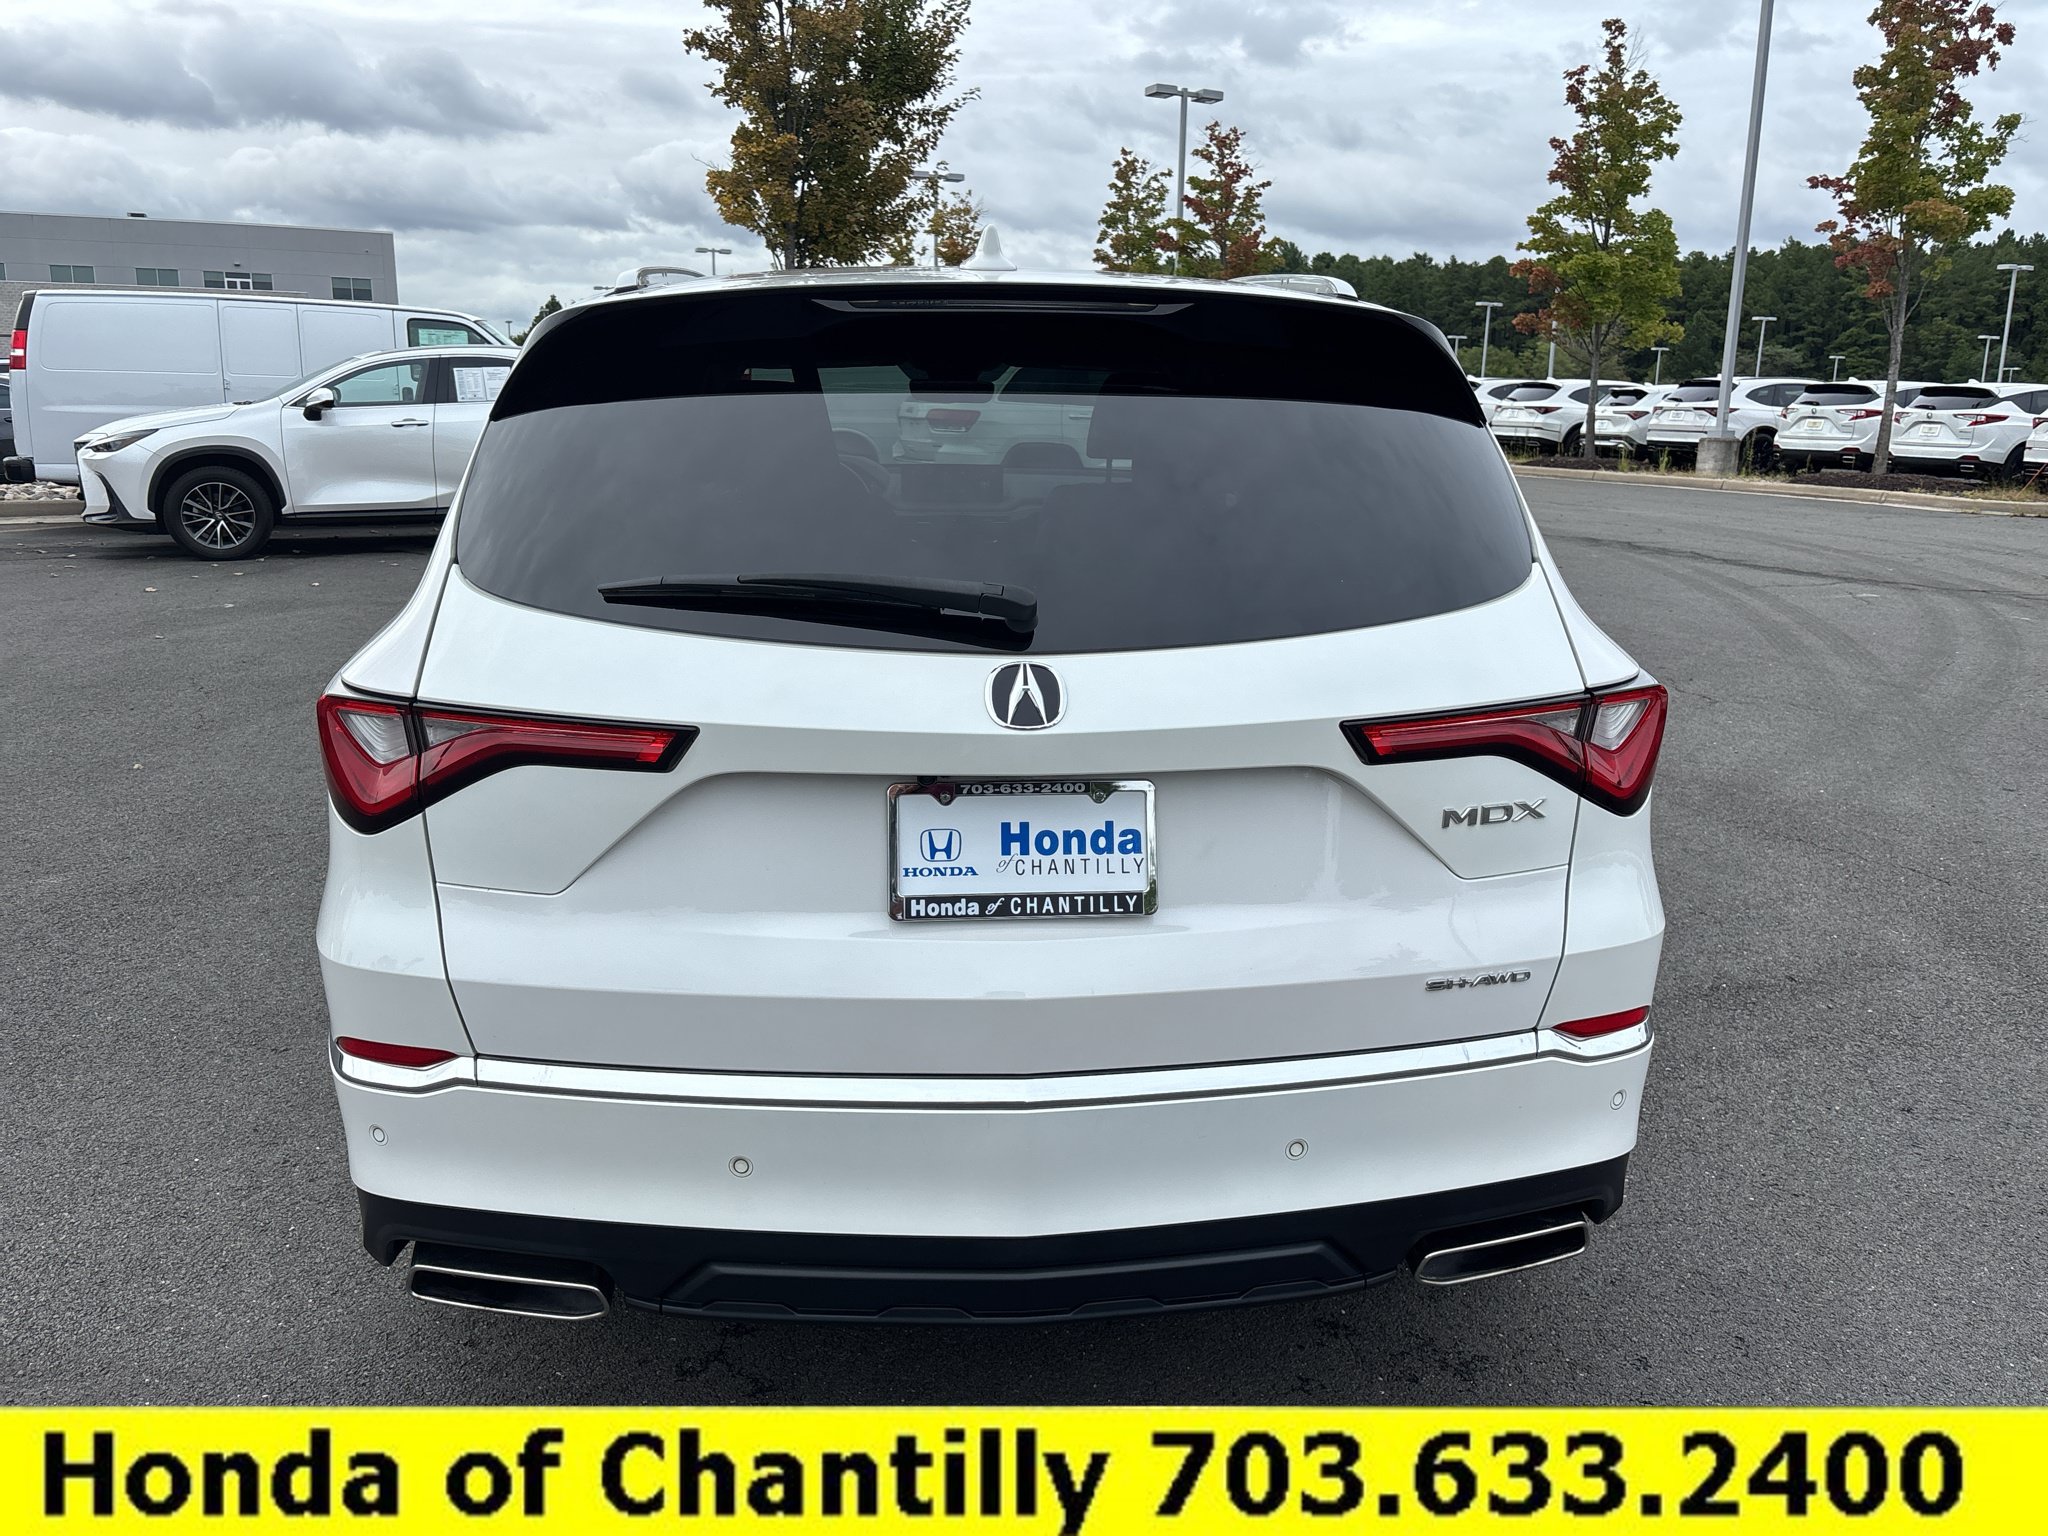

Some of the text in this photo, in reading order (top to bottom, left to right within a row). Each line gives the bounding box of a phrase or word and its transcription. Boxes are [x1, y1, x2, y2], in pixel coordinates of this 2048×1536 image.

[960, 783, 1086, 794] 703-633-2400
[1441, 798, 1547, 829] MDX
[1000, 820, 1143, 856] Honda
[902, 866, 979, 877] HONDA
[995, 853, 1144, 876] of CHANTILLY
[910, 895, 1138, 917] Honda of CHANTILLY
